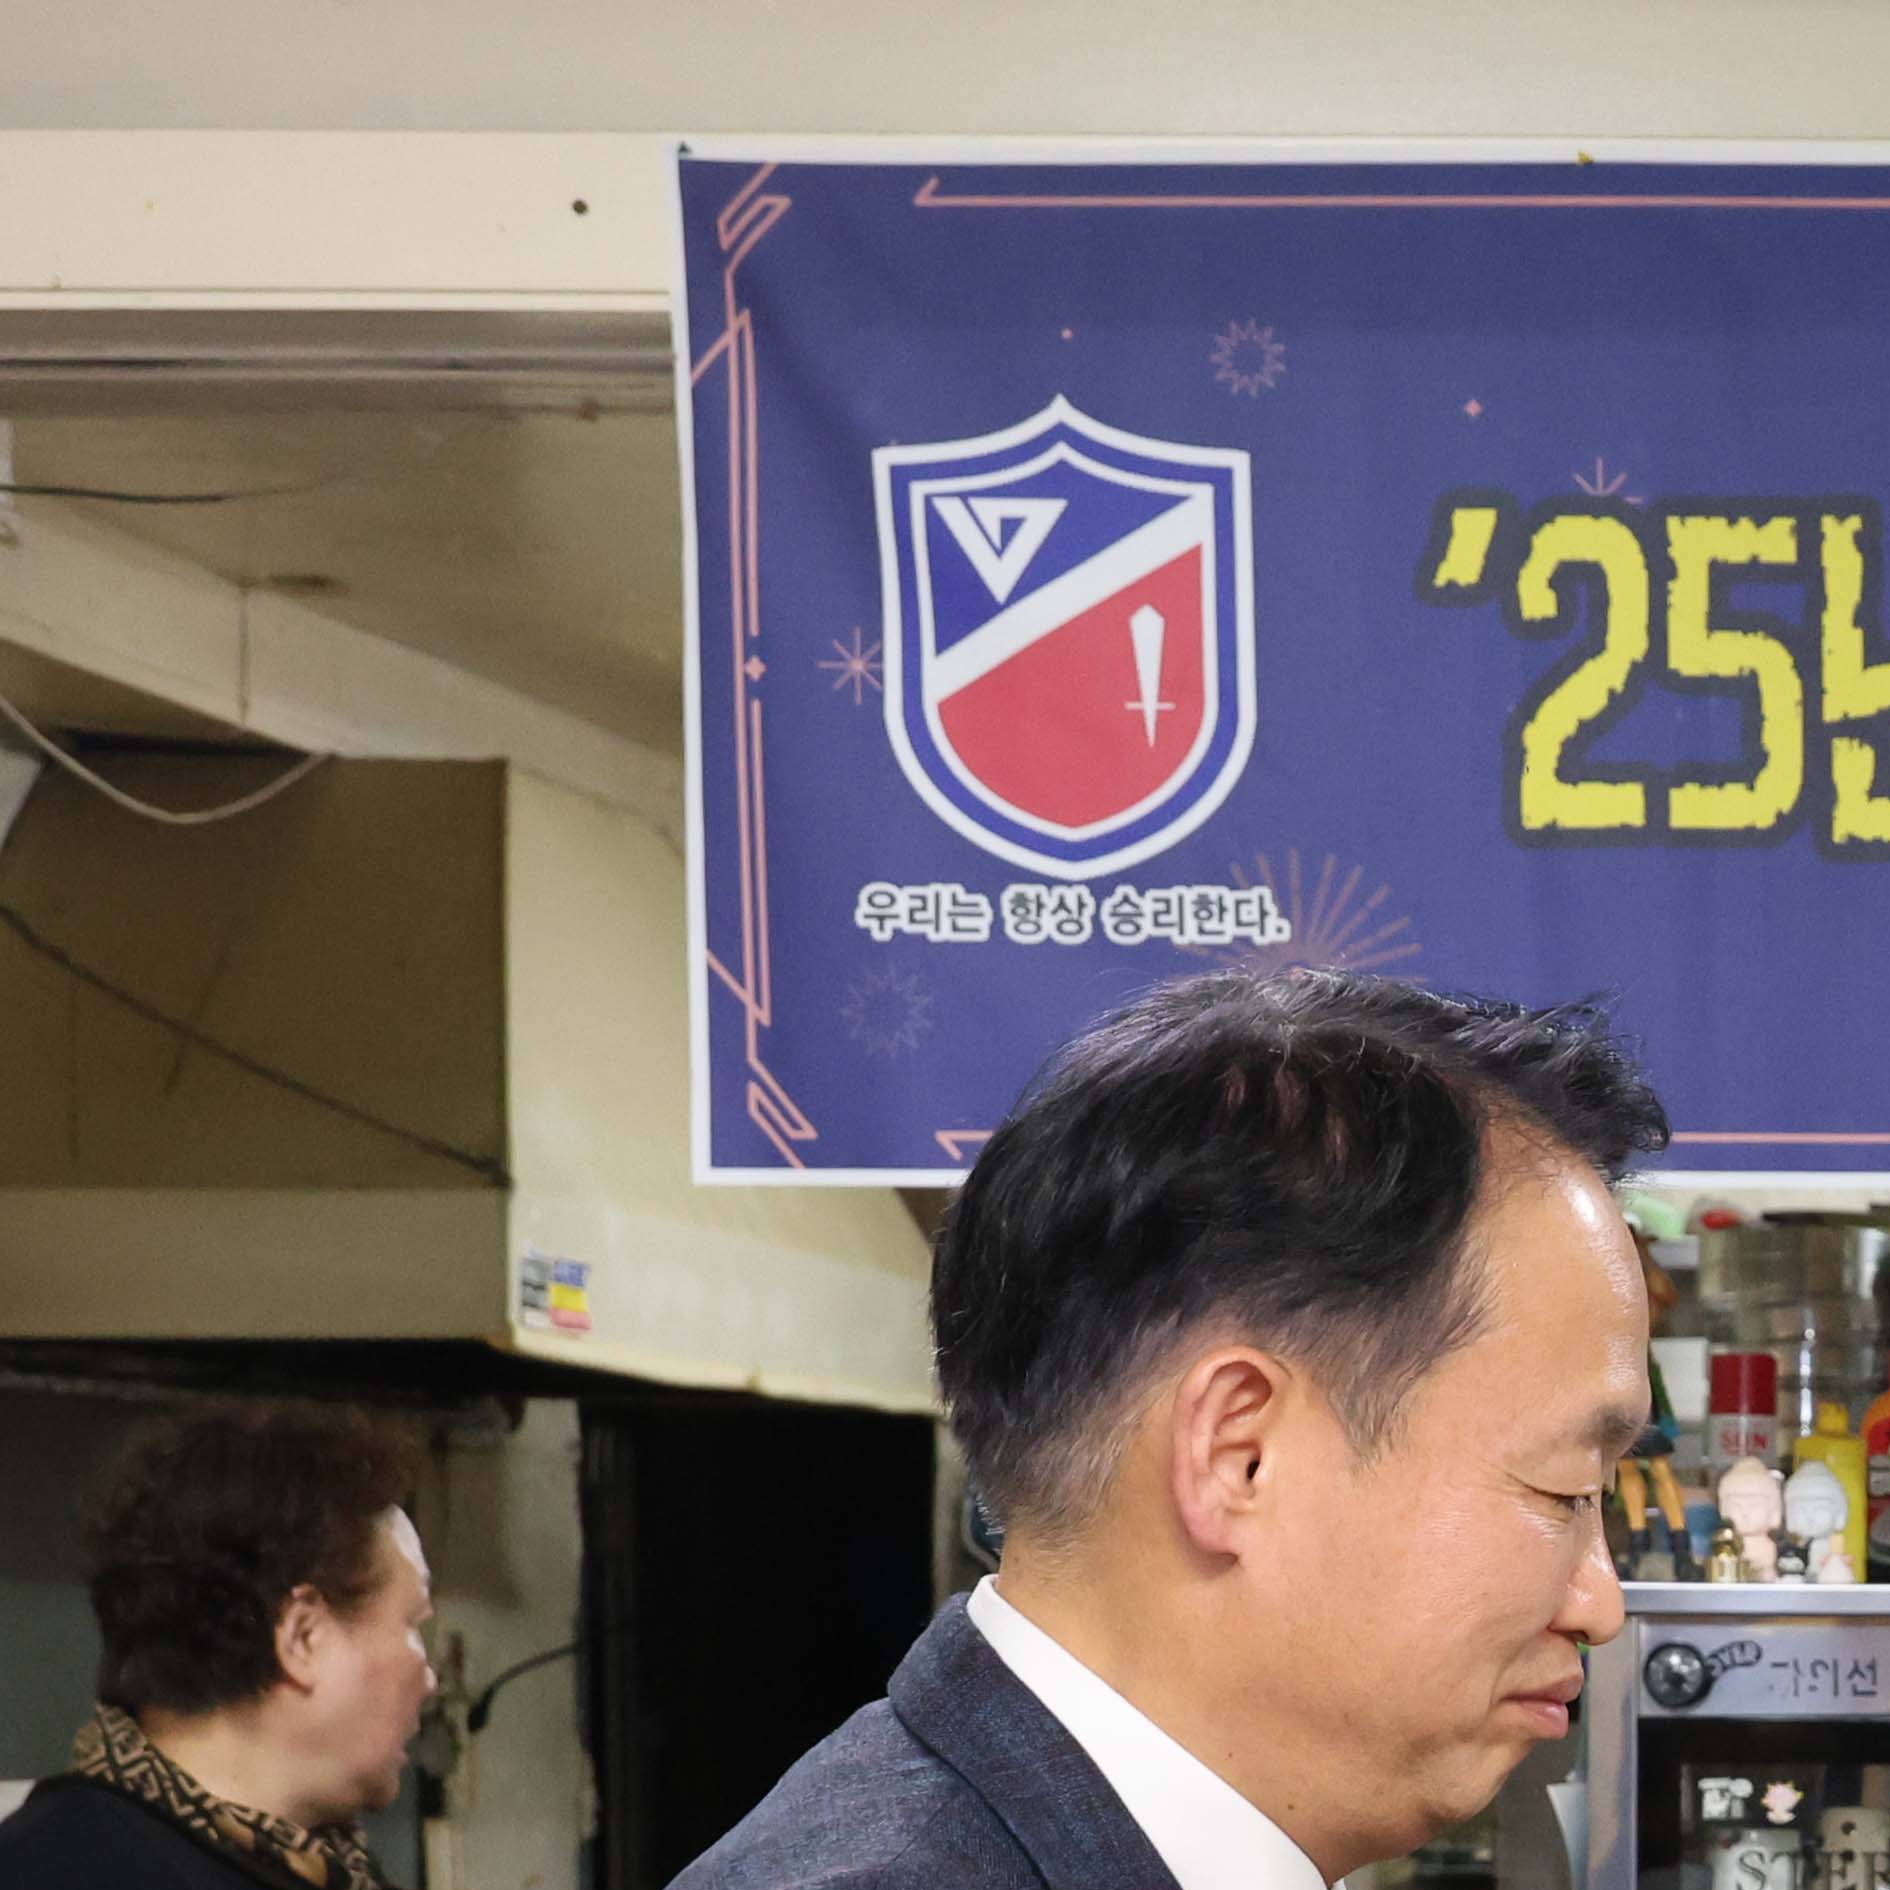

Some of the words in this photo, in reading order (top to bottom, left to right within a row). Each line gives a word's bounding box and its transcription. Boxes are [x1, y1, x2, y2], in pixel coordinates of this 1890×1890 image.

[862, 888, 988, 936] 우리는
[1009, 888, 1088, 937] 항상
[1107, 888, 1287, 938] 승리한다.
